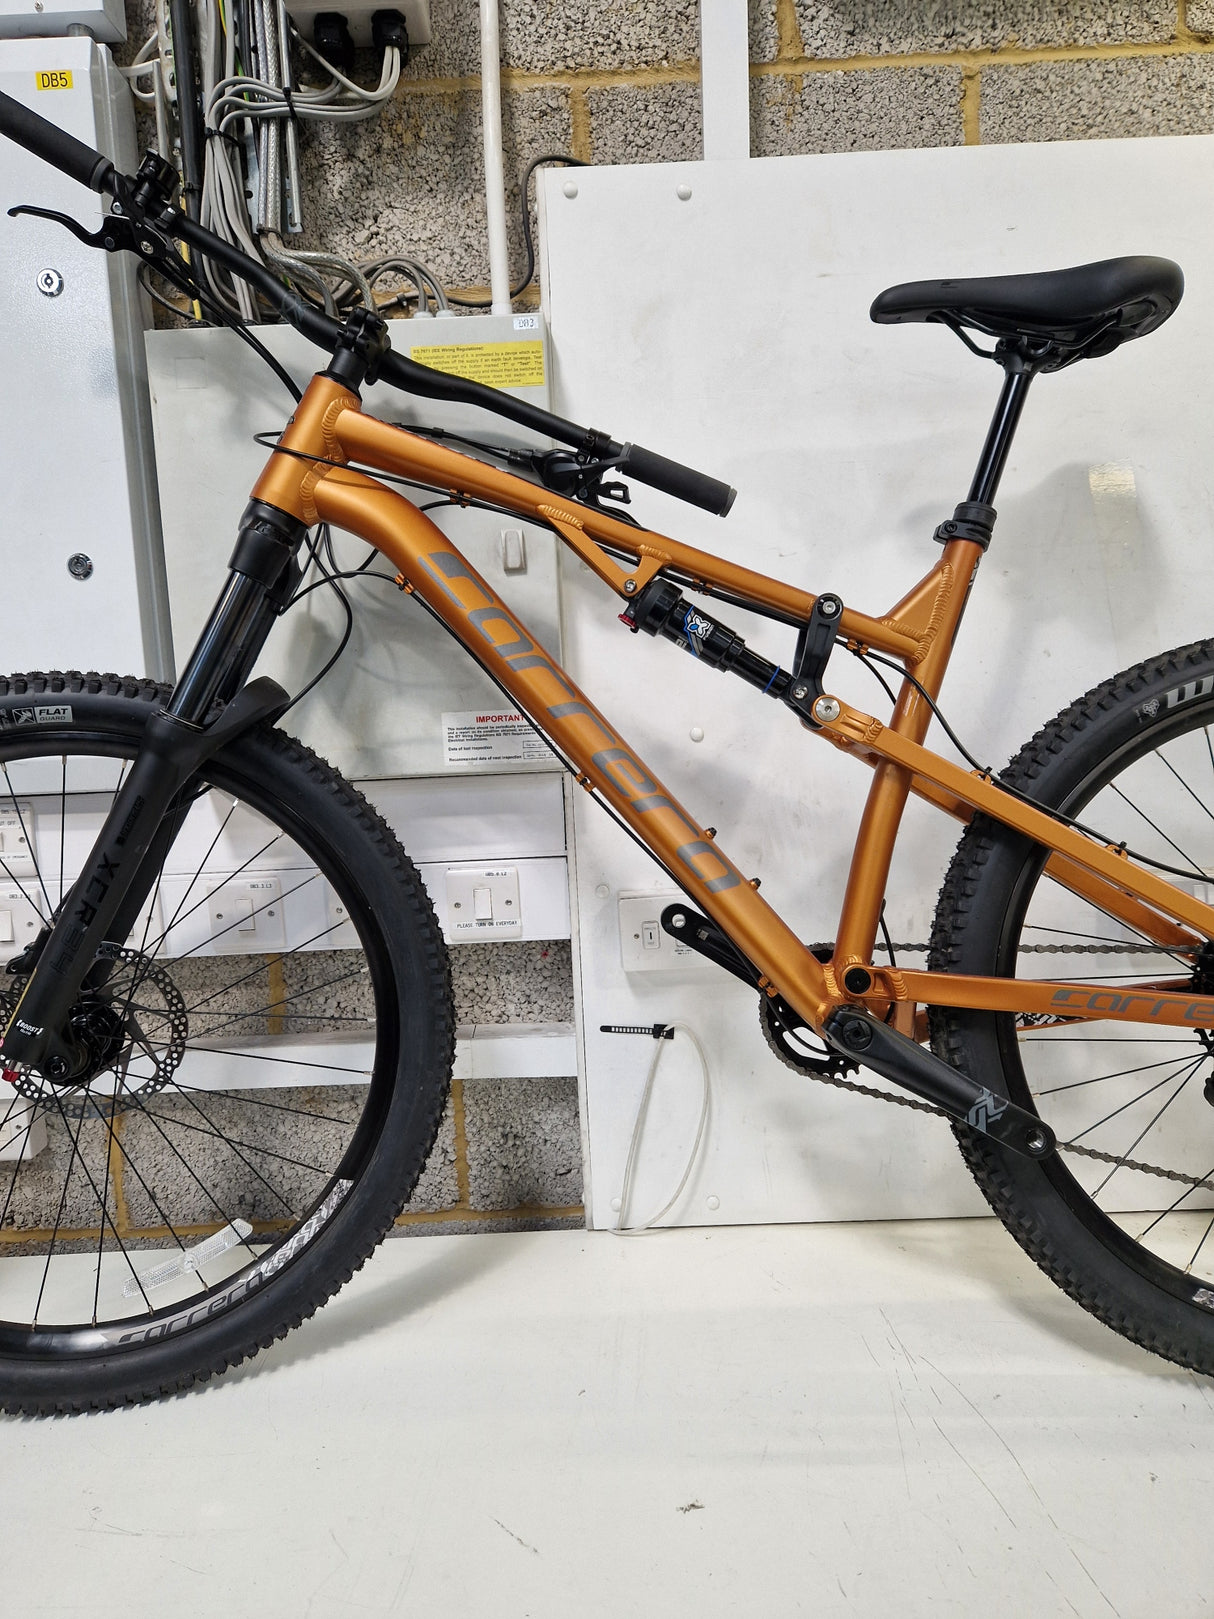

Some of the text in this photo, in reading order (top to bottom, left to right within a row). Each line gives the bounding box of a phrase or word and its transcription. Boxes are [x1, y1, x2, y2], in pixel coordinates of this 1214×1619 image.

[41, 72, 68, 88] DB5
[39, 708, 68, 716] FLAT
[475, 714, 524, 723] IMPORTANT
[417, 551, 741, 893] carrera
[75, 852, 120, 926] XCR
[20, 1021, 39, 1033] BOOST
[119, 1271, 264, 1343] carrera
